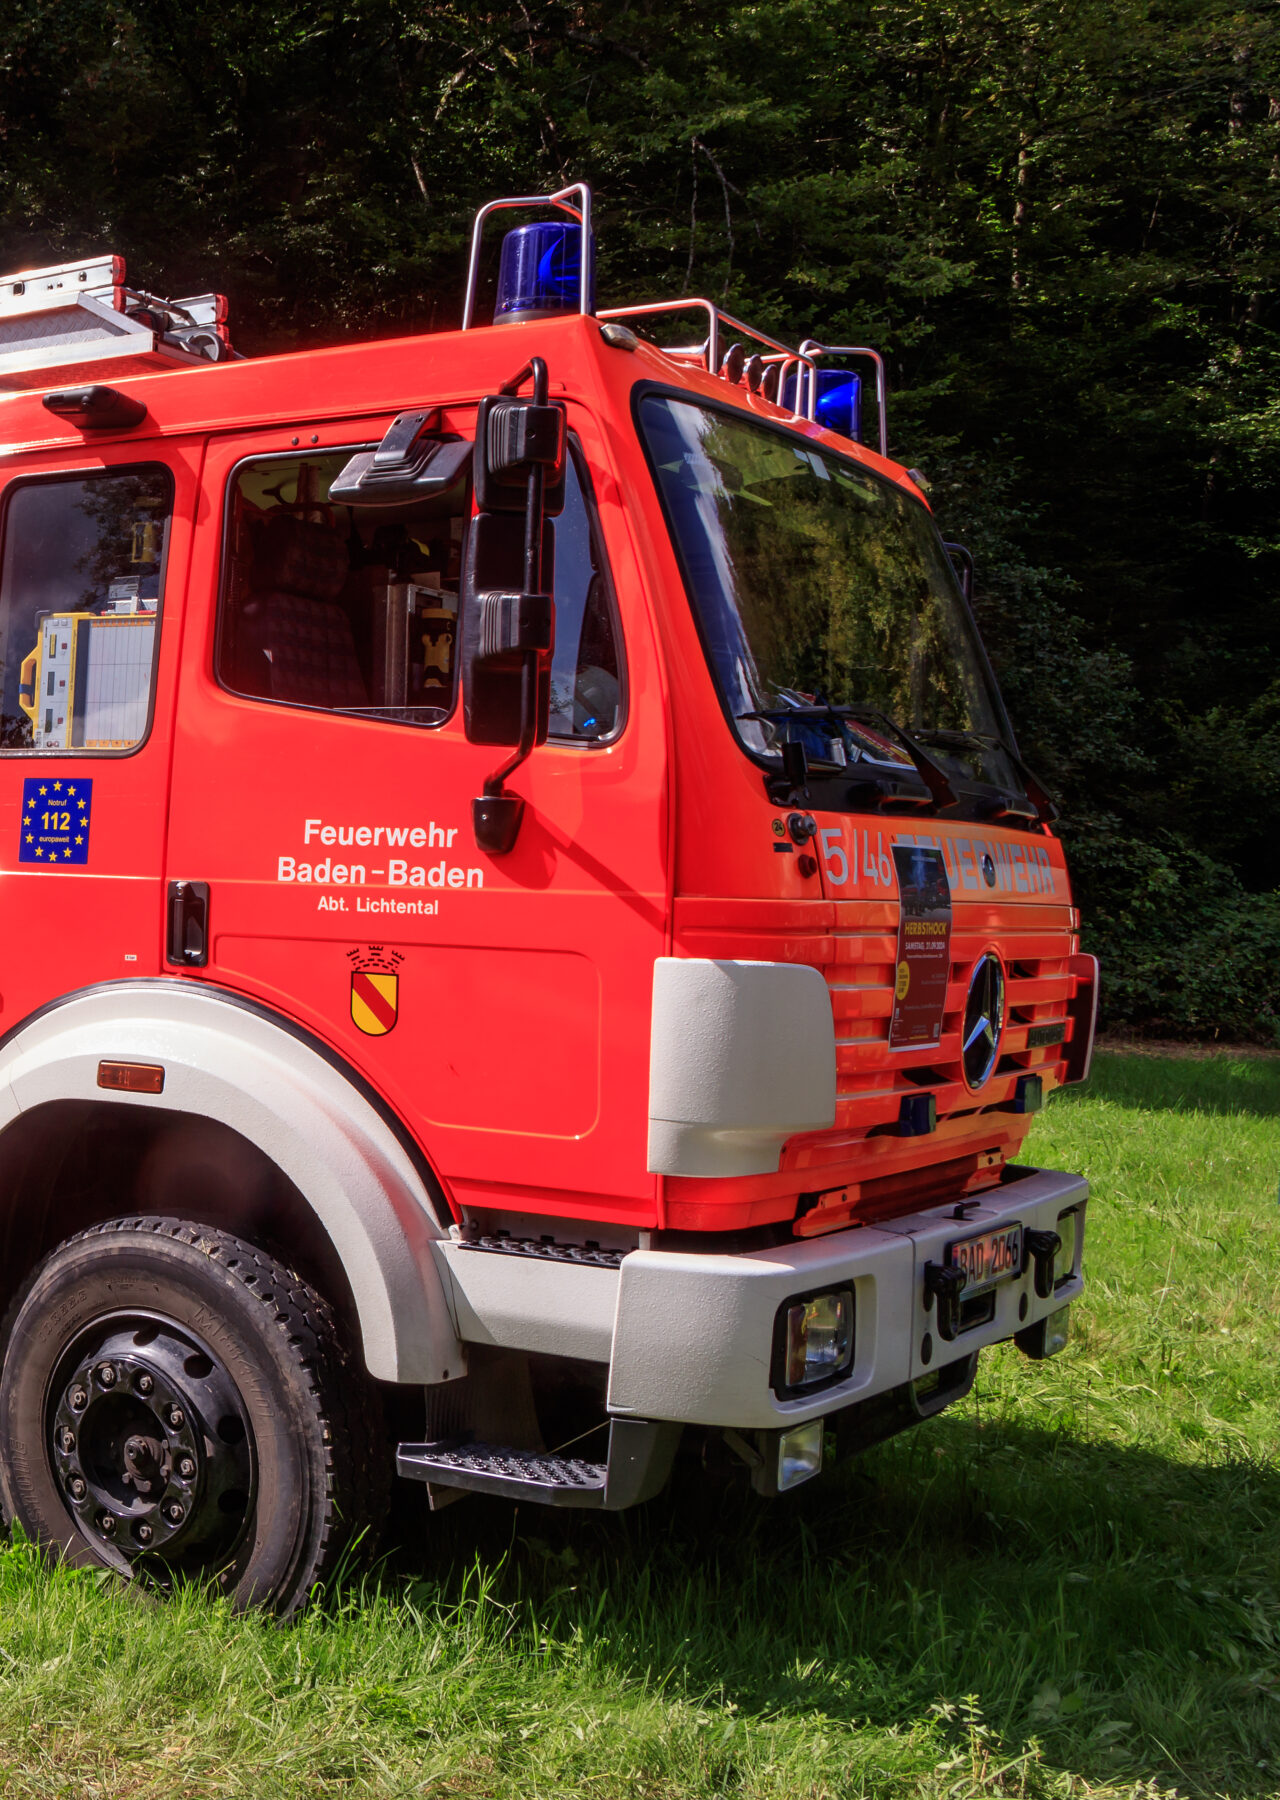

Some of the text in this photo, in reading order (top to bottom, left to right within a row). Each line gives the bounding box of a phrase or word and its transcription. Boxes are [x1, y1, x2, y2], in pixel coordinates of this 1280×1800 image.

[41, 812, 71, 831] 112
[304, 819, 458, 848] Feuerwehr
[317, 896, 439, 915] Abt. Lichtental
[904, 921, 947, 935] HERBSTHOCK
